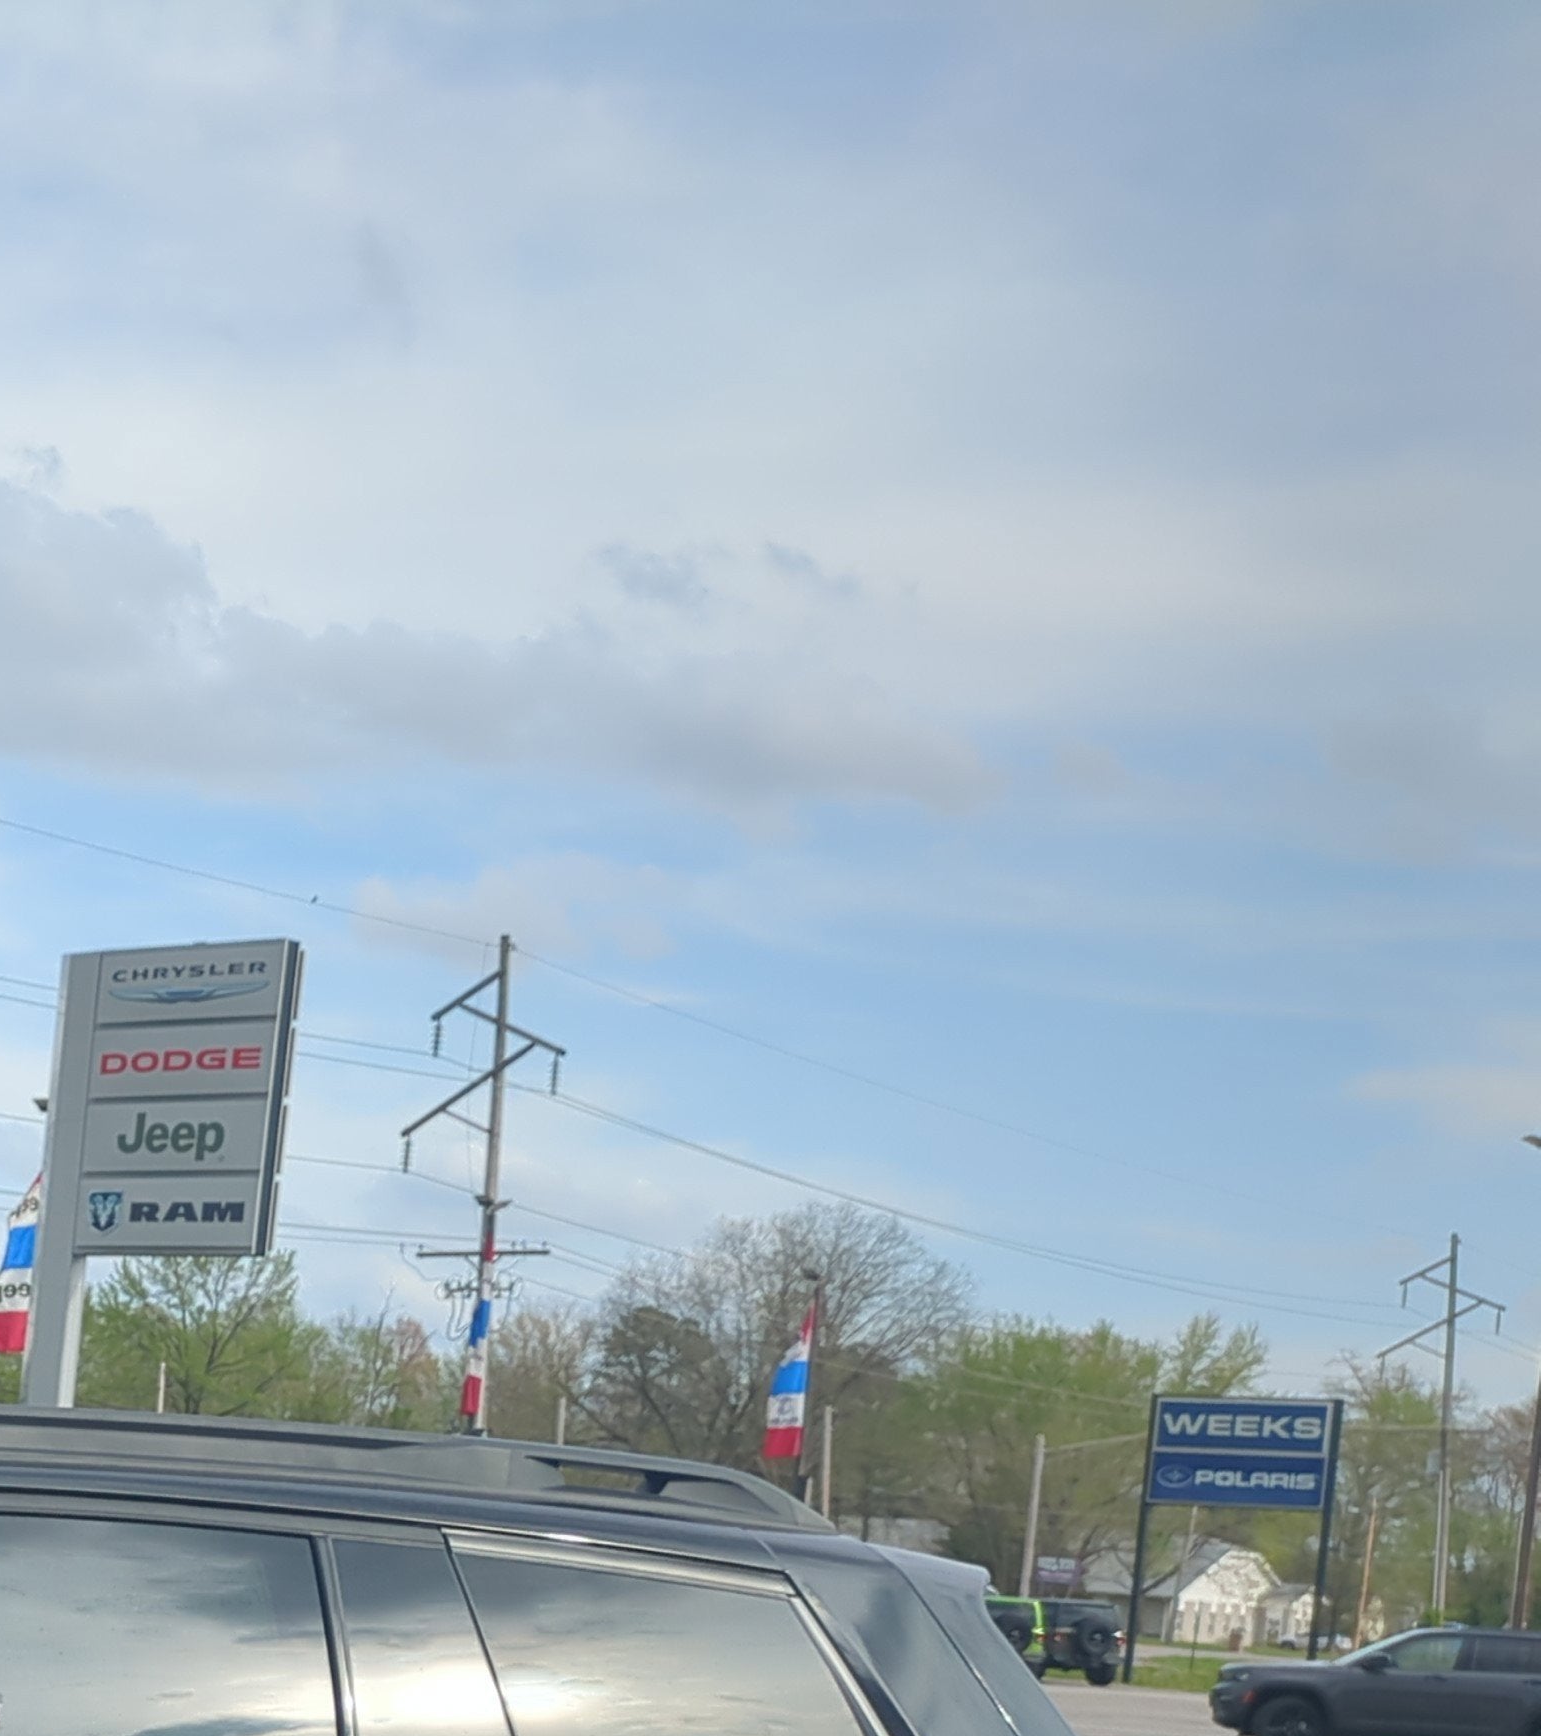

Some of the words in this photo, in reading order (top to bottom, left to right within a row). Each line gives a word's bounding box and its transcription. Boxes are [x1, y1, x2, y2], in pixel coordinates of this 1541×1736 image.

[112, 960, 268, 983] CHRYSLER
[99, 1046, 262, 1075] DODGE
[117, 1112, 225, 1161] Jeep
[129, 1201, 245, 1223] RAM
[1164, 1412, 1321, 1439] WEEKS
[1194, 1468, 1316, 1490] POLARIS
